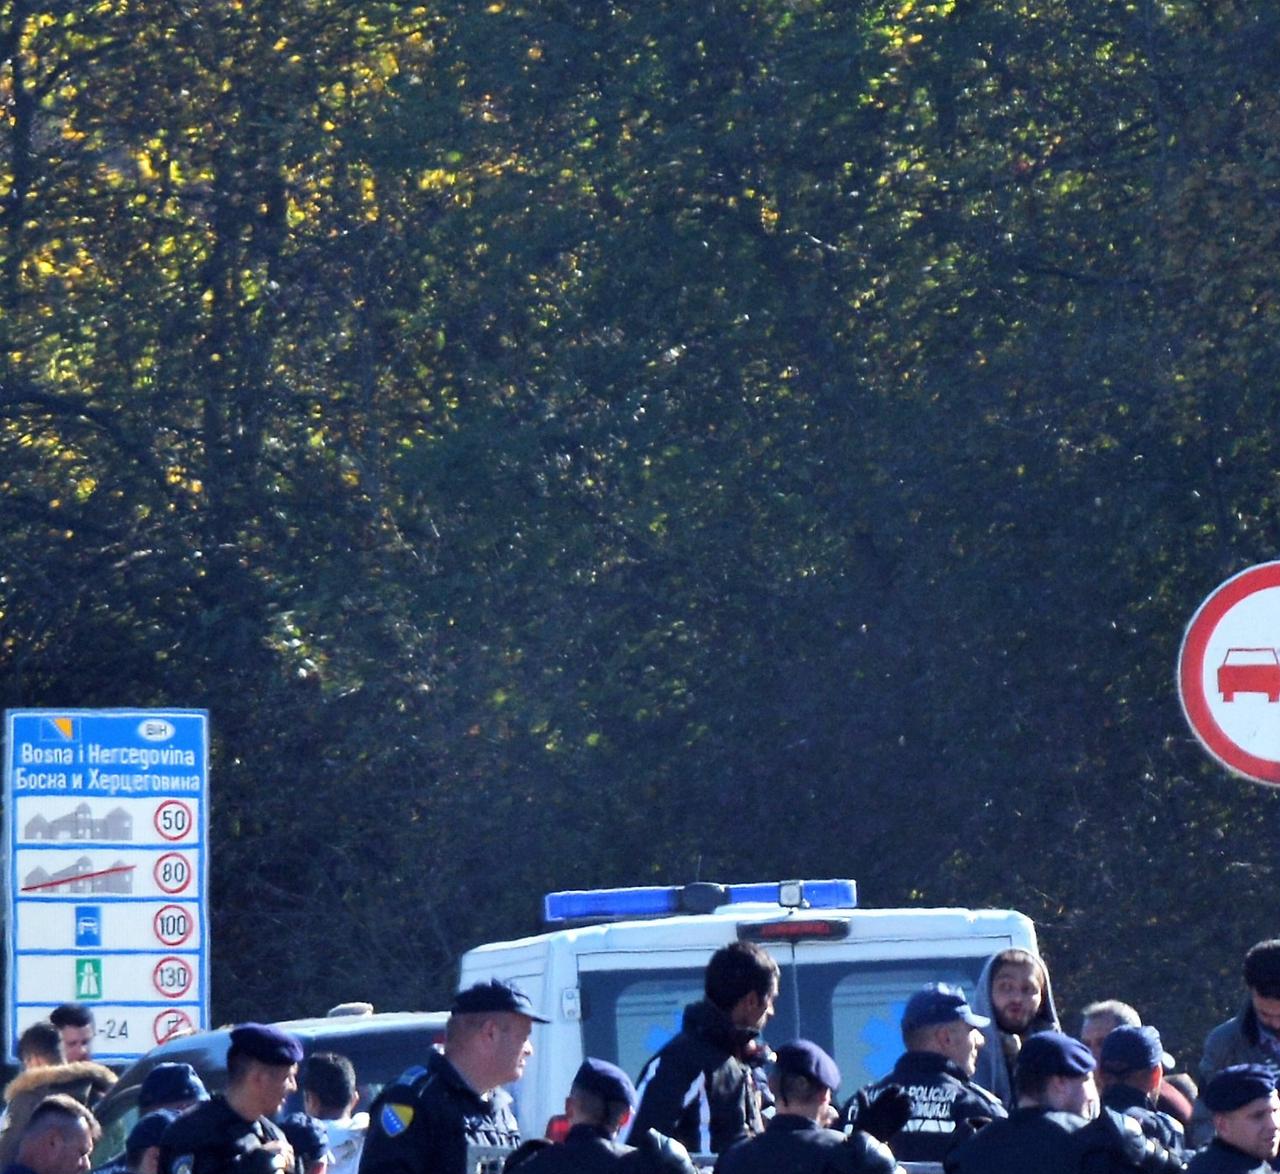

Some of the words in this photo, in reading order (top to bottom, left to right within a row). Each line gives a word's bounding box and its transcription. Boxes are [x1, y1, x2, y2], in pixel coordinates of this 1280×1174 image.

[21, 743, 73, 765] Bosna
[79, 744, 84, 764] i
[88, 743, 195, 770] Hercegovina
[16, 767, 67, 790] Босна
[72, 772, 83, 789] и
[88, 767, 200, 795] Херцеговина
[162, 809, 186, 831] 50
[162, 862, 186, 883] 80
[160, 914, 187, 936] 100
[160, 966, 187, 988] 130
